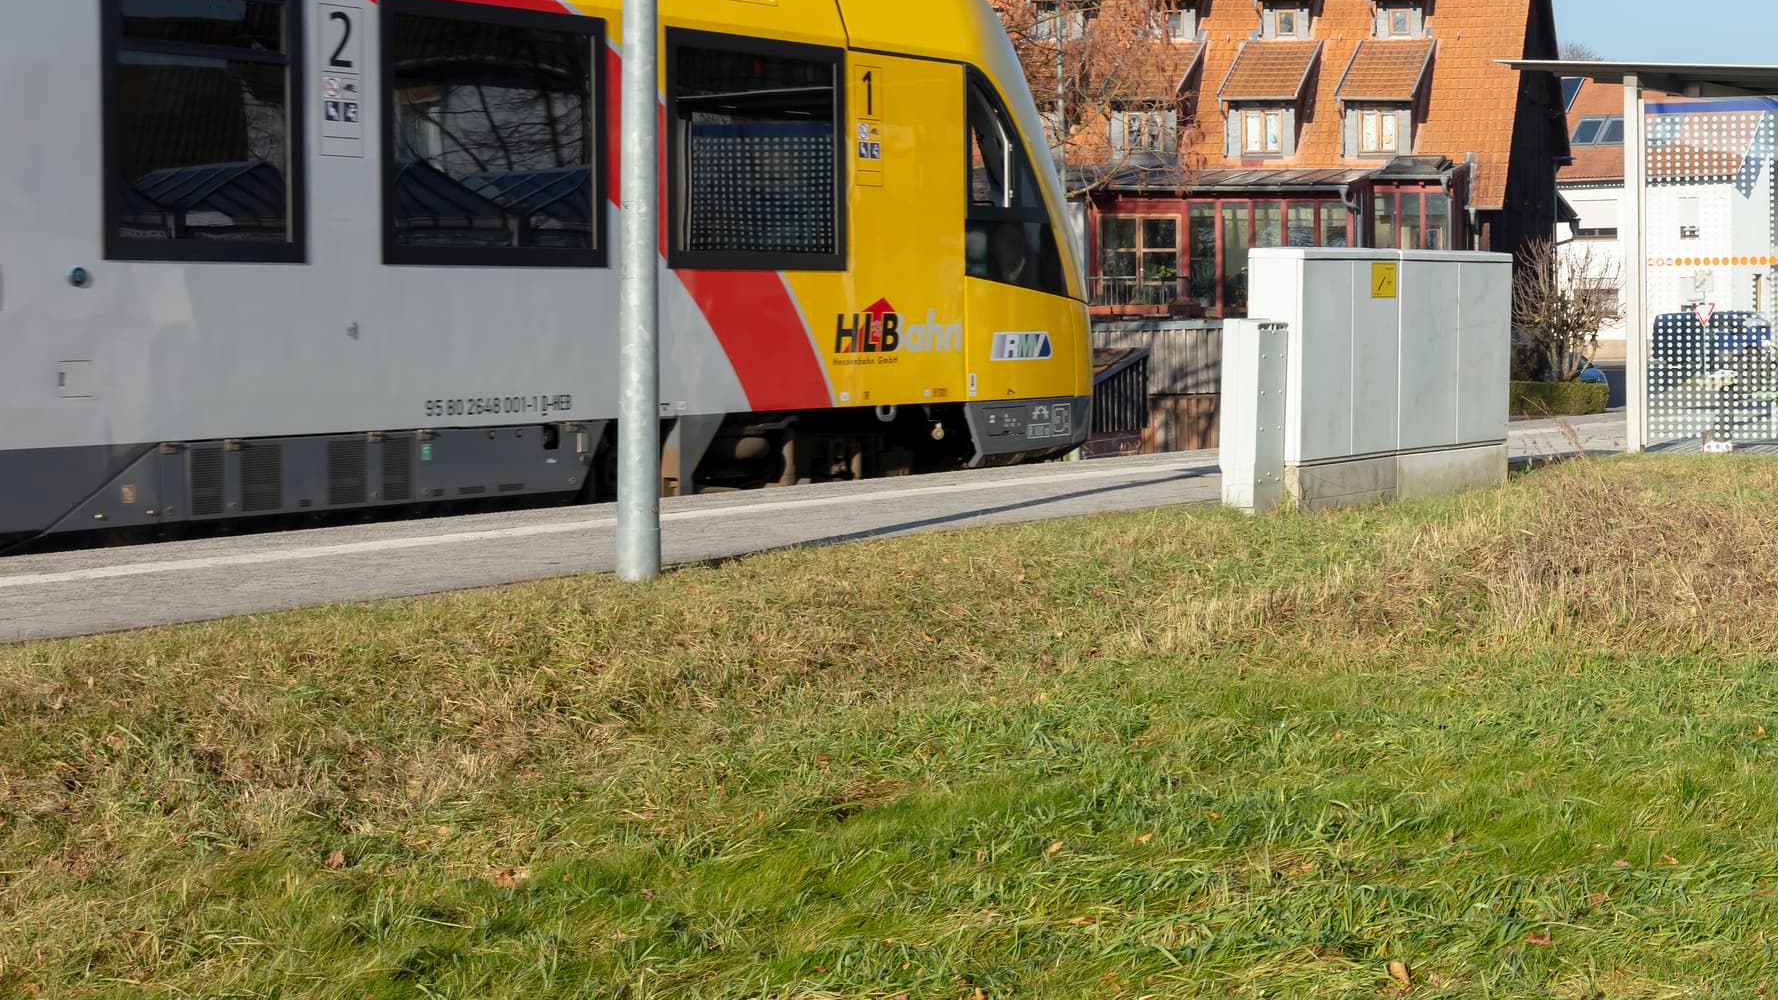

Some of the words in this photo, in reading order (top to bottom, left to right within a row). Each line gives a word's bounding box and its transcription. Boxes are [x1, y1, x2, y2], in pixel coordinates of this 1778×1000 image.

[329, 11, 353, 68] 2
[862, 70, 872, 116] 1
[1003, 333, 1046, 358] RMV
[424, 399, 444, 417] 95
[446, 398, 465, 416] 80
[467, 397, 501, 415] 2648
